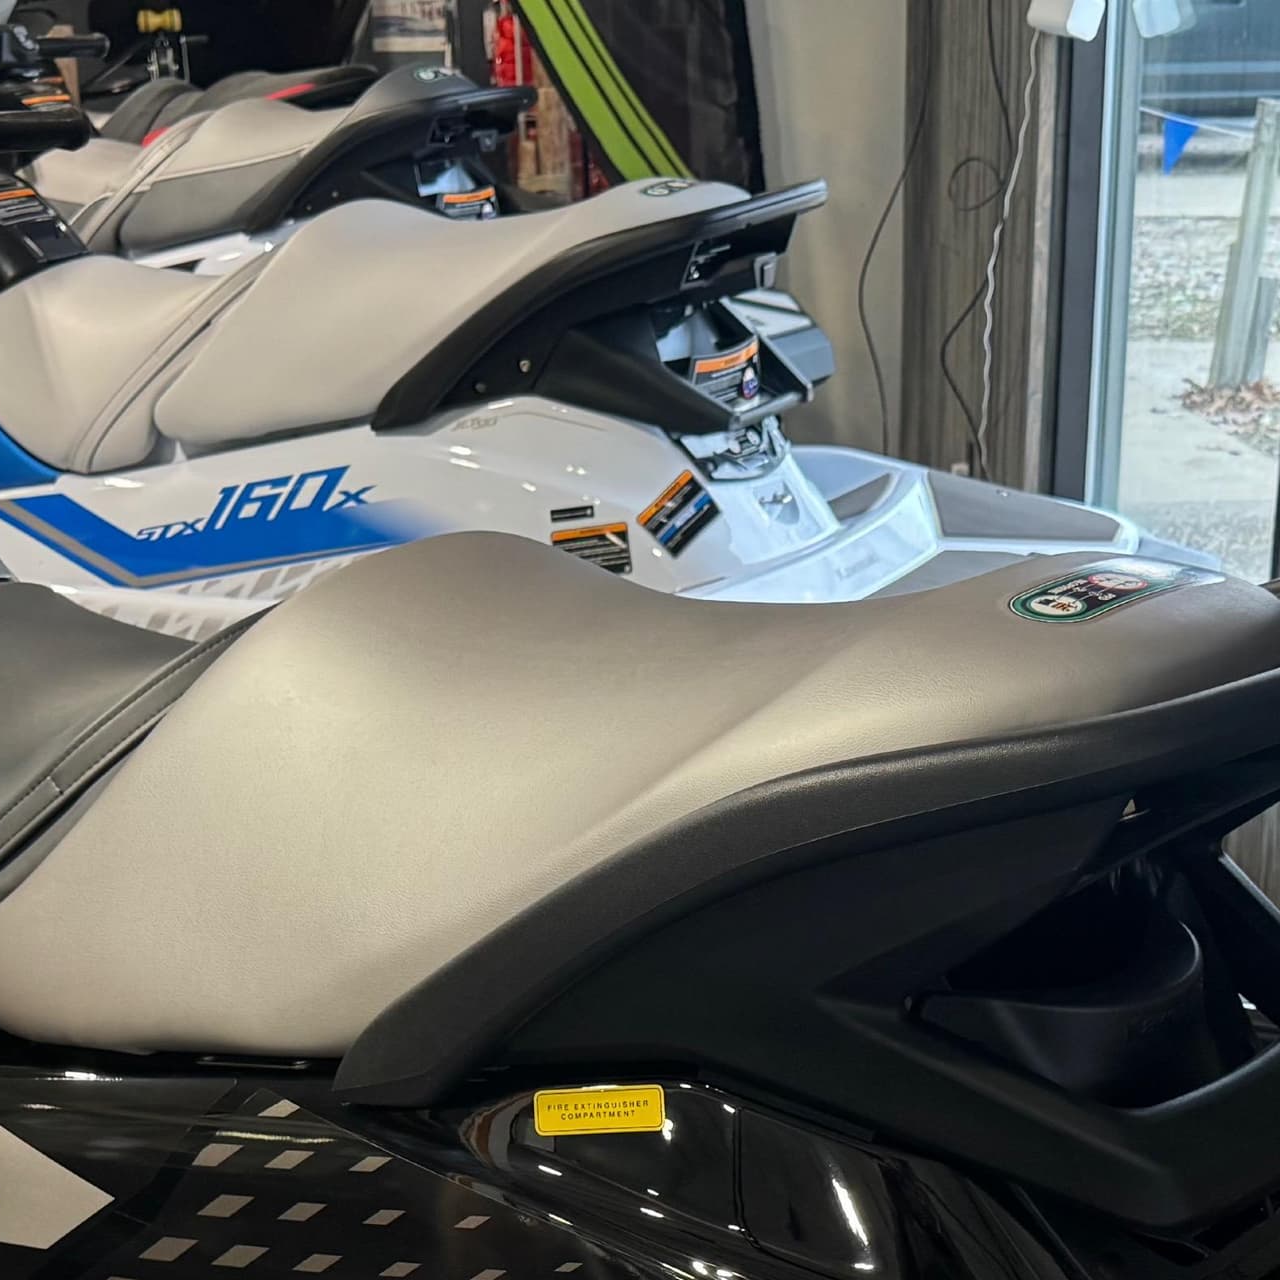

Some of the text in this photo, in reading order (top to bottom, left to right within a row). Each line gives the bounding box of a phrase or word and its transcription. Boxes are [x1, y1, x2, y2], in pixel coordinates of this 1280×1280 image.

[547, 1099, 650, 1112] FIRE EXTINGUISHER
[560, 1110, 636, 1121] COMPARTMENT
